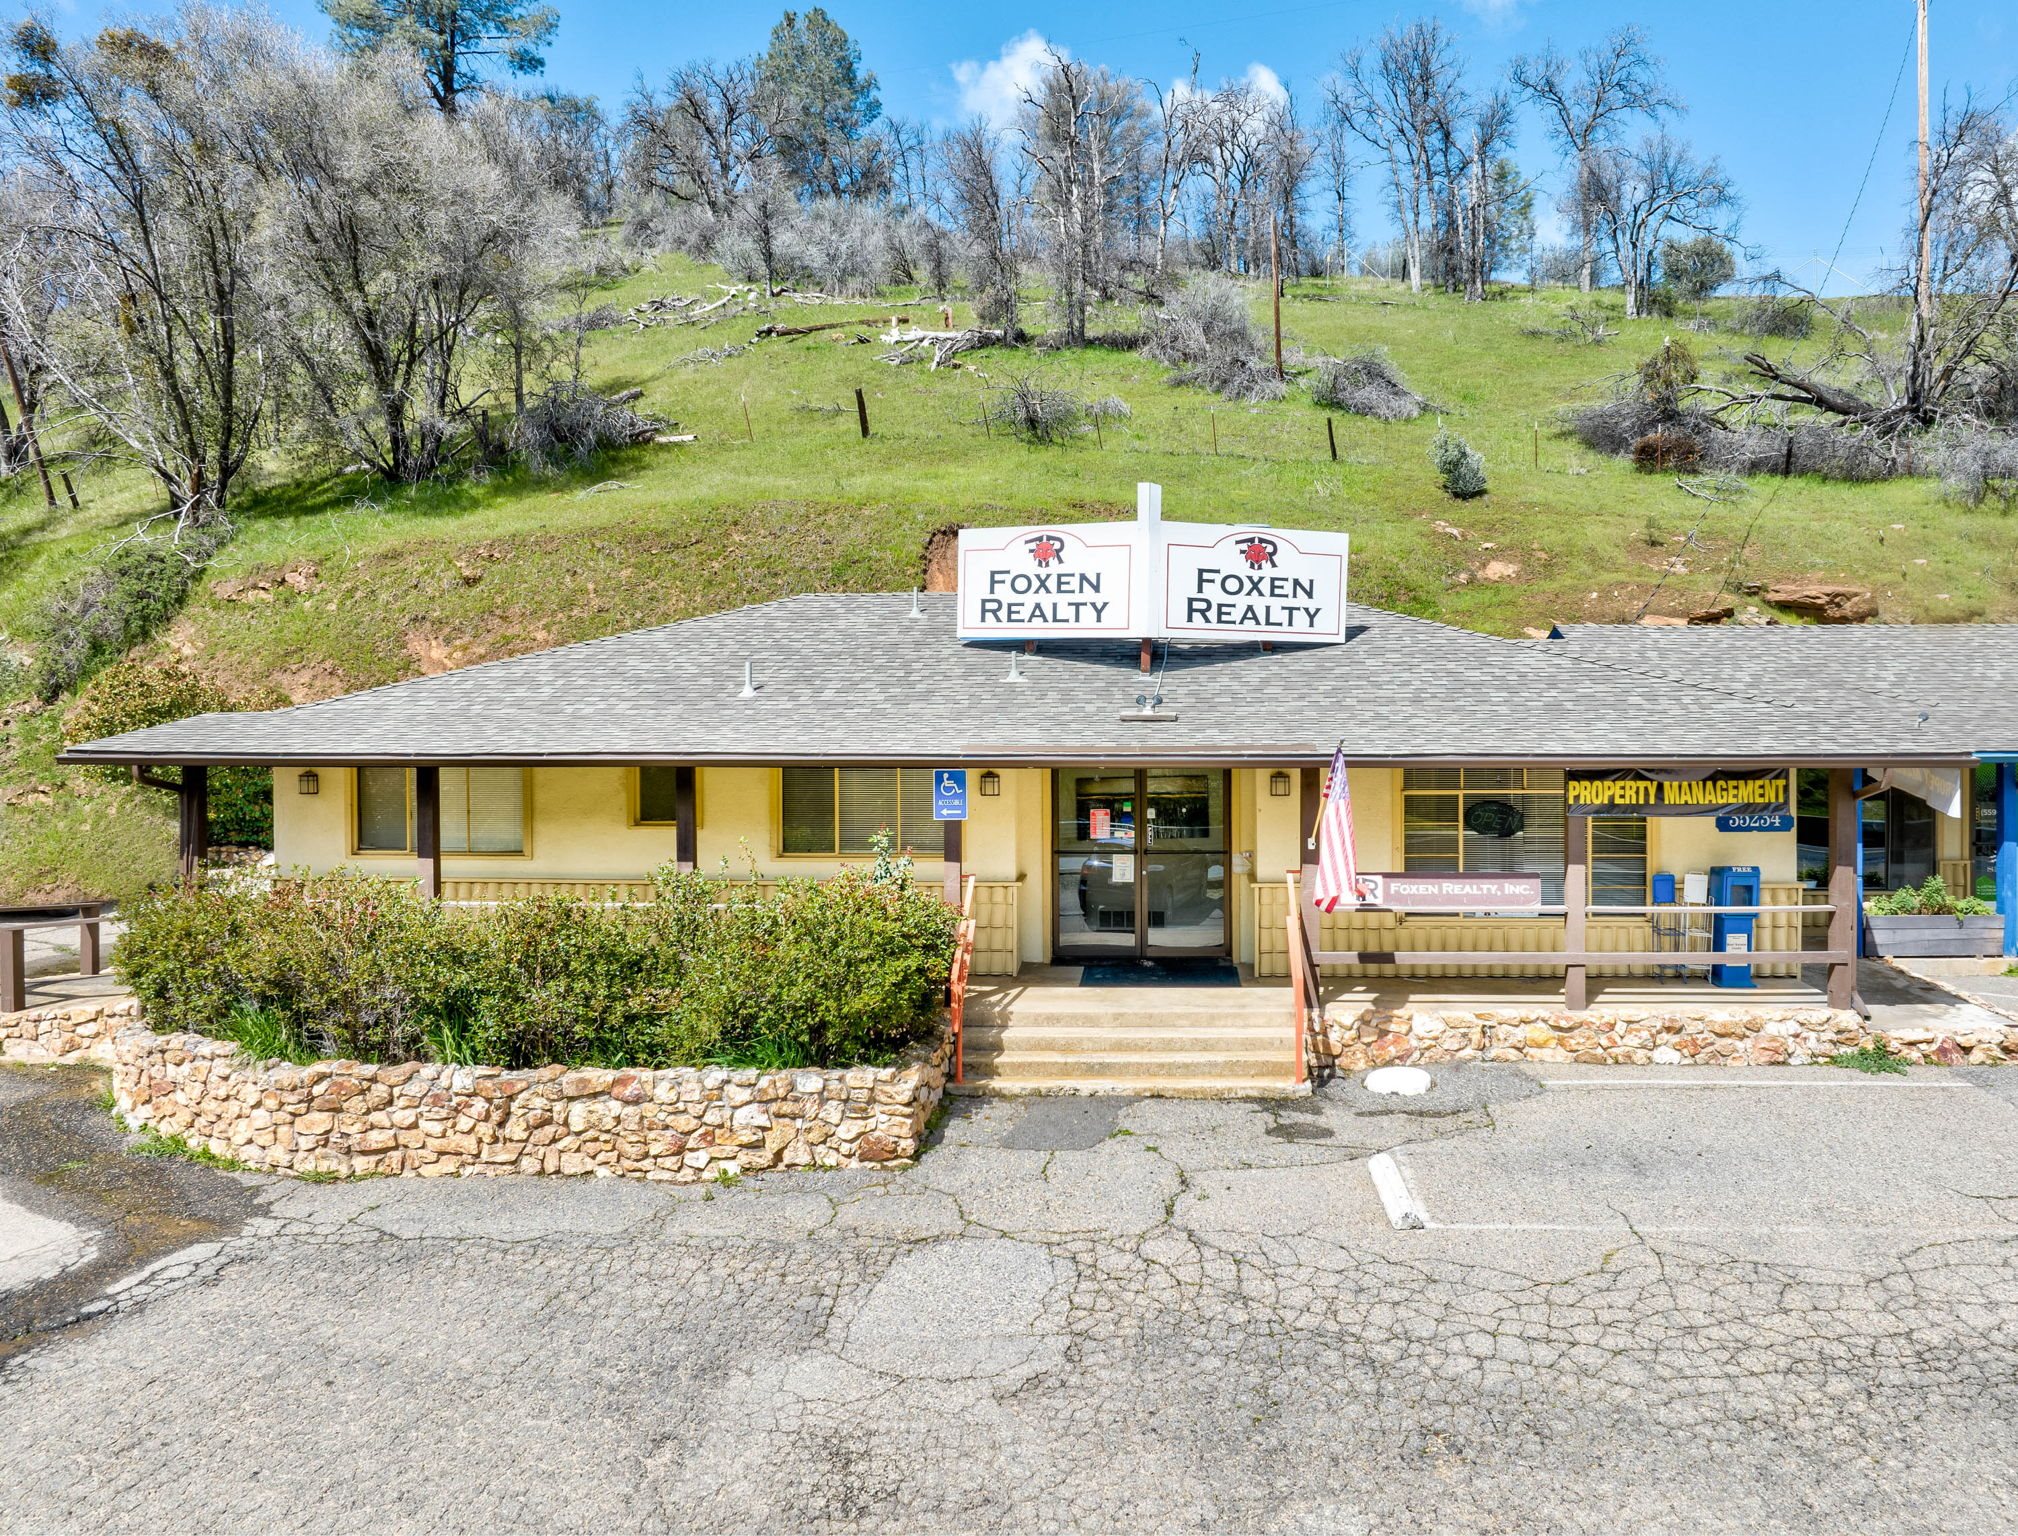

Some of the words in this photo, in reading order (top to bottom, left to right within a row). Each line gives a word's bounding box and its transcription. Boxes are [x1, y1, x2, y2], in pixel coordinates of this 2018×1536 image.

[1568, 780, 1658, 805] PROPERTY
[1663, 779, 1786, 805] MANAGEMENT
[1470, 811, 1521, 830] OPEN
